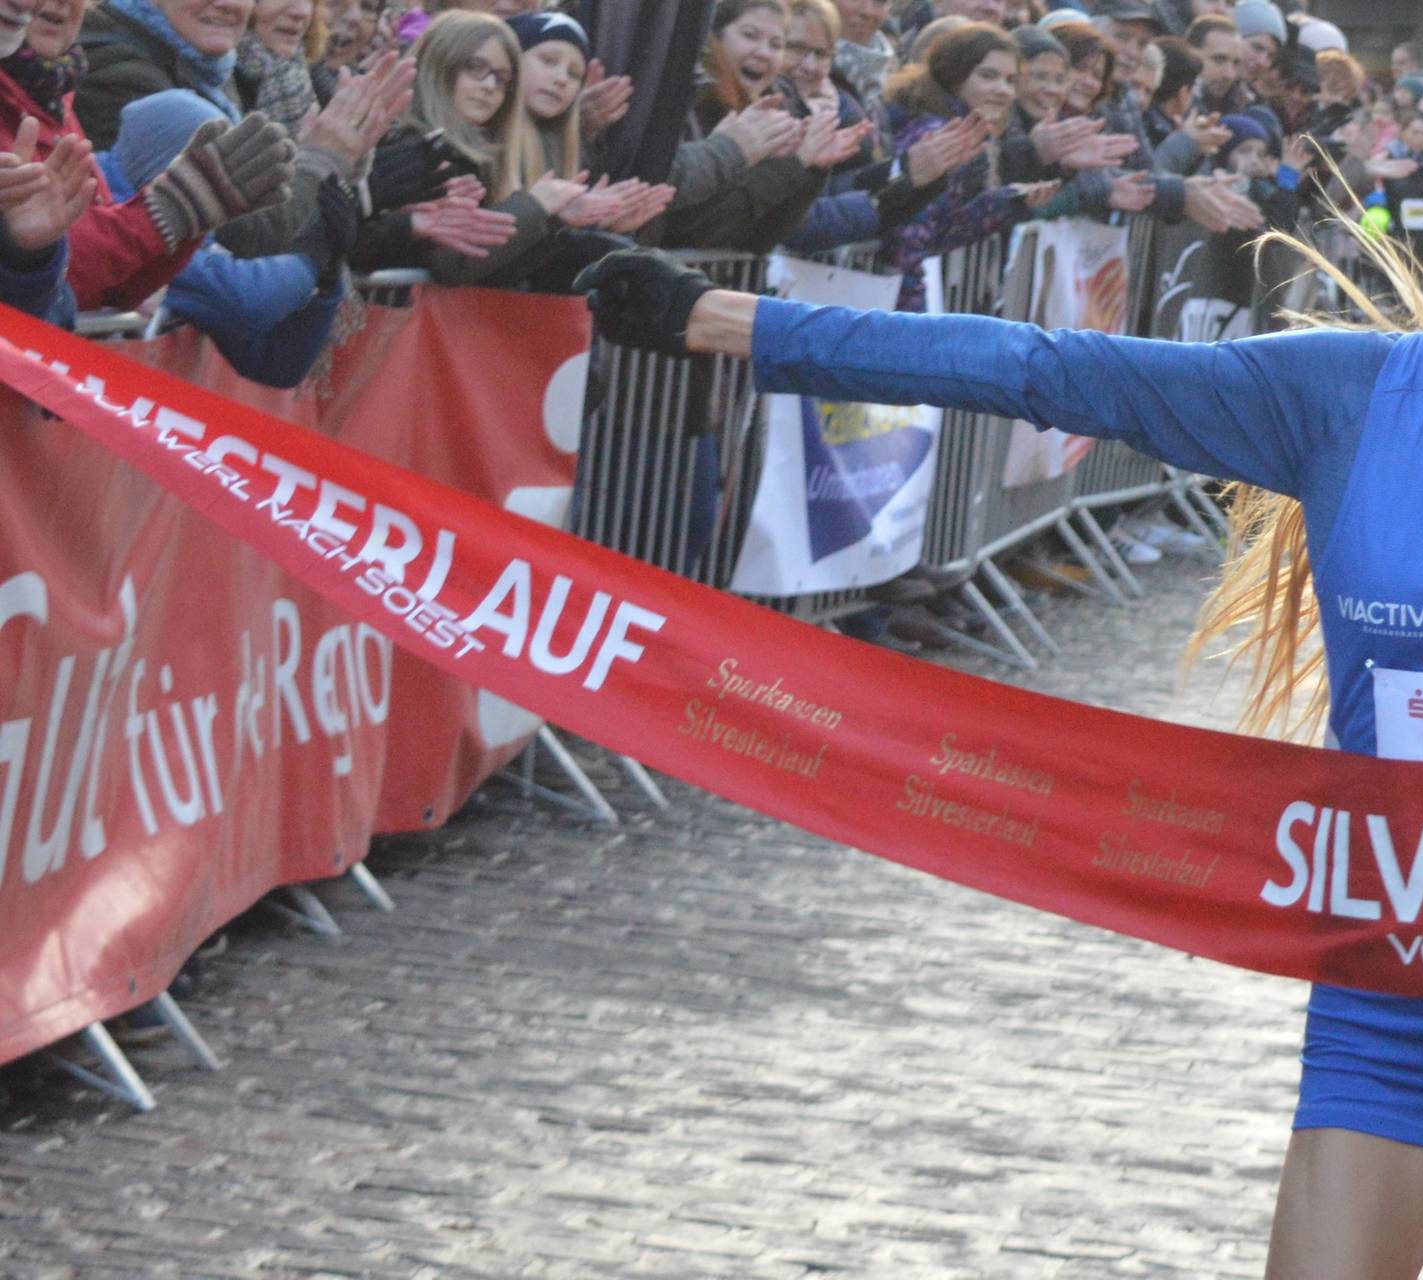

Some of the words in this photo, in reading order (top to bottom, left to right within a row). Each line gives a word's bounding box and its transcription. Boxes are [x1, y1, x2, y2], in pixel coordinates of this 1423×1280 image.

[354, 566, 486, 660] SOEST
[707, 657, 843, 731] Sparkassen
[678, 698, 830, 780] Silvesterlauf
[930, 732, 1055, 797] Sparkassen
[897, 774, 1041, 849] Silvesterlauf
